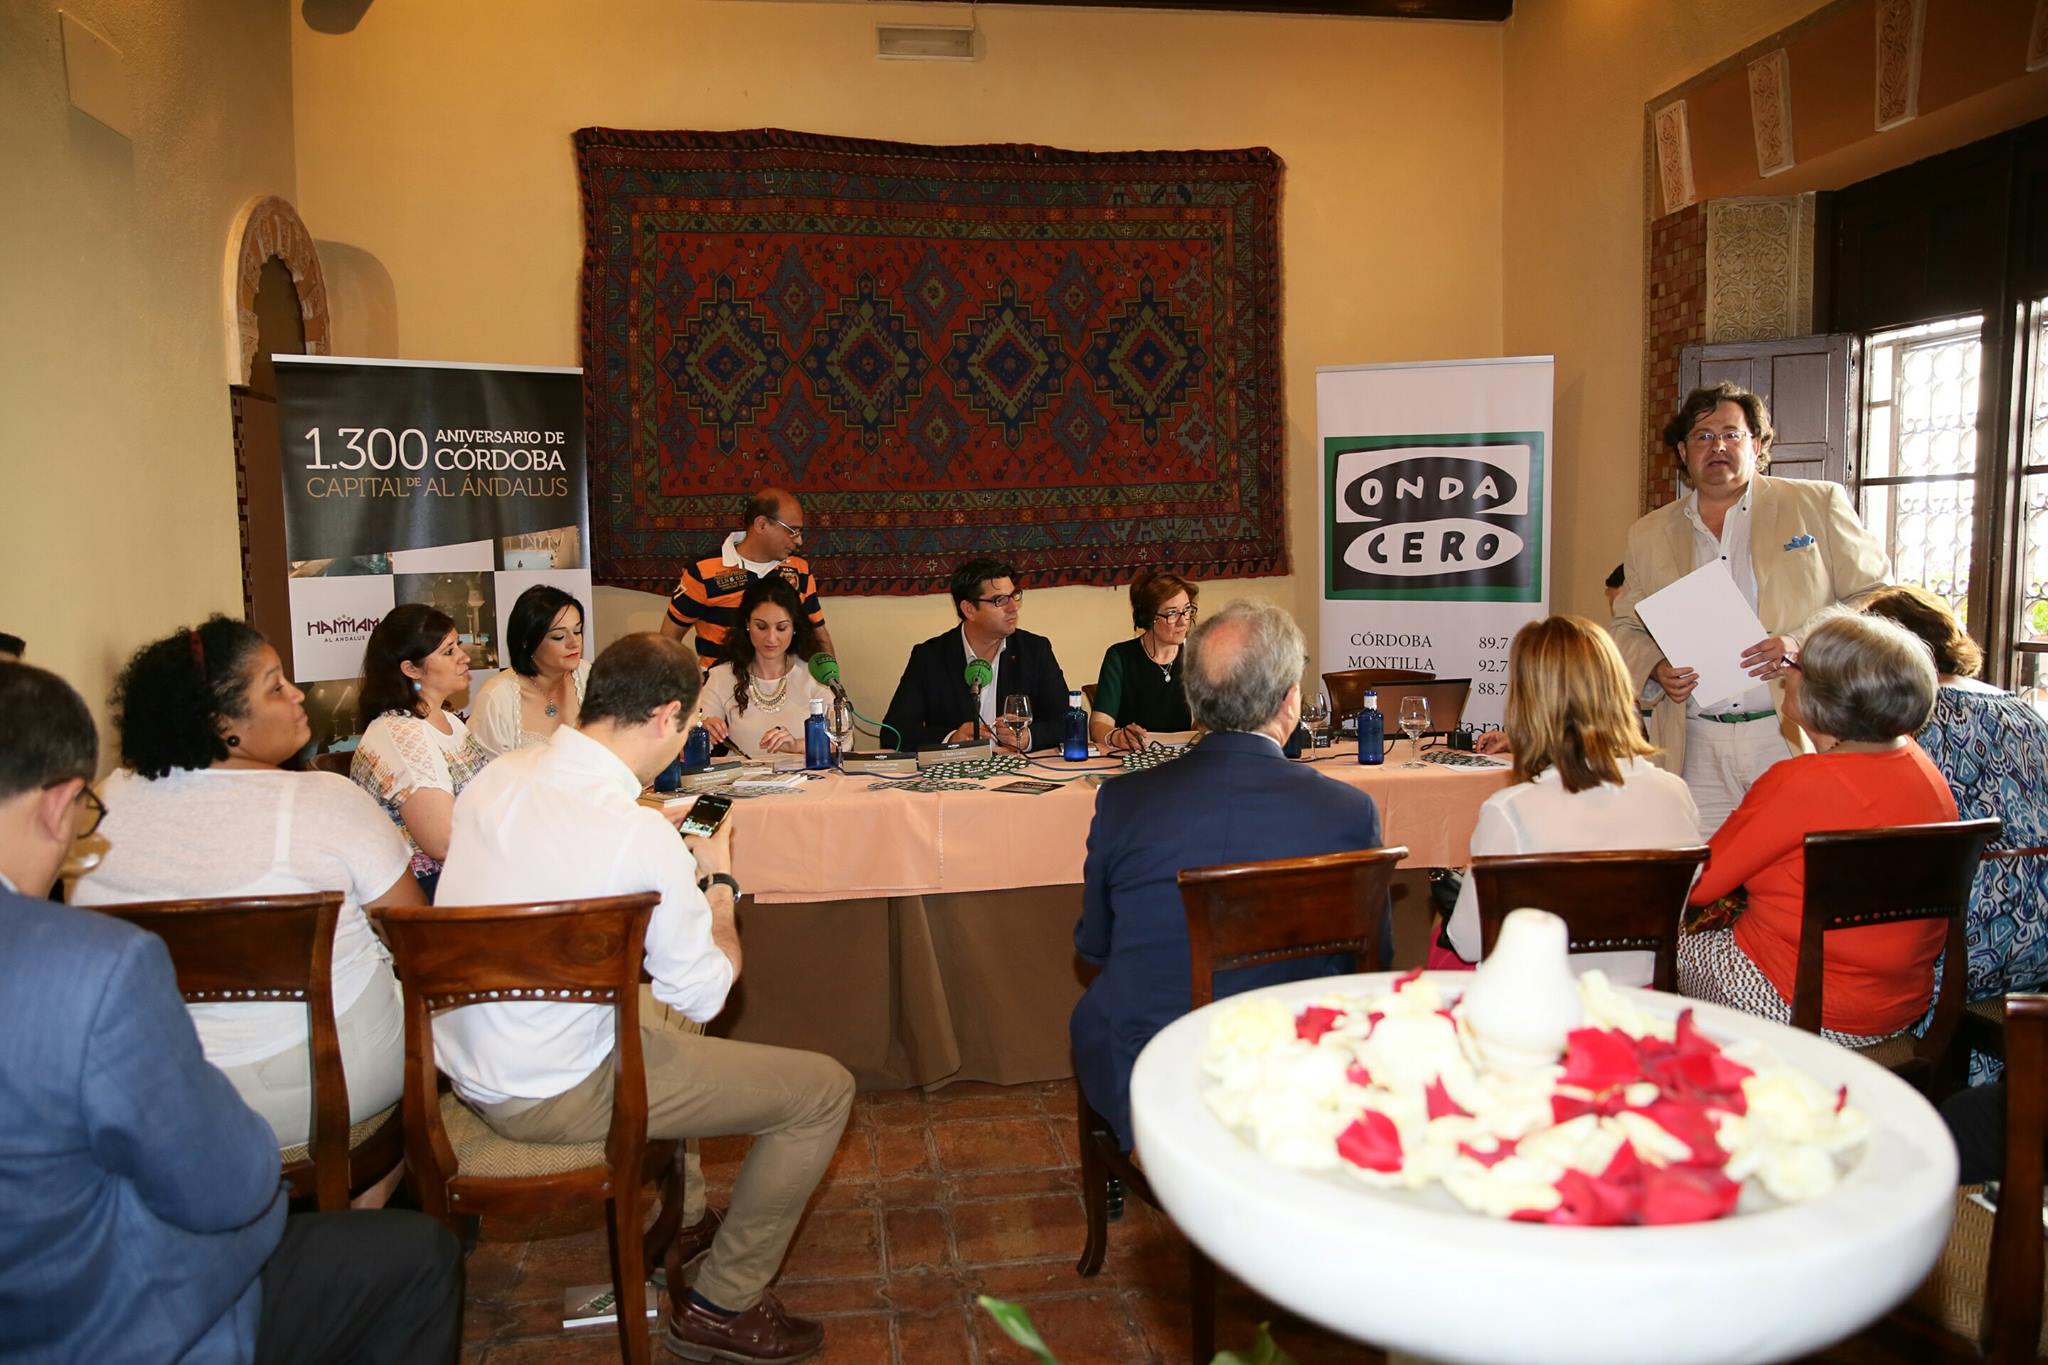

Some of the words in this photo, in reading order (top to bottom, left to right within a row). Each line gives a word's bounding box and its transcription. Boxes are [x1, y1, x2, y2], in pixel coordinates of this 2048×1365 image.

[304, 427, 428, 470] 1.300
[435, 429, 541, 444] ANIVERSARIO
[544, 431, 565, 444] DE
[434, 443, 566, 471] CÓRDOBA
[306, 476, 410, 498] CAPITAL
[406, 477, 422, 487] DE
[424, 477, 455, 497] AL
[460, 472, 568, 497] ÁNDALUS
[1360, 475, 1500, 506] ONDA
[1367, 530, 1500, 564] CERO
[1350, 631, 1433, 648] CÓRDOBA
[1478, 637, 1509, 650] 89.7
[1348, 655, 1435, 671] MONTILLA
[1478, 659, 1509, 673] 92.7
[1478, 682, 1508, 696] 88.7
